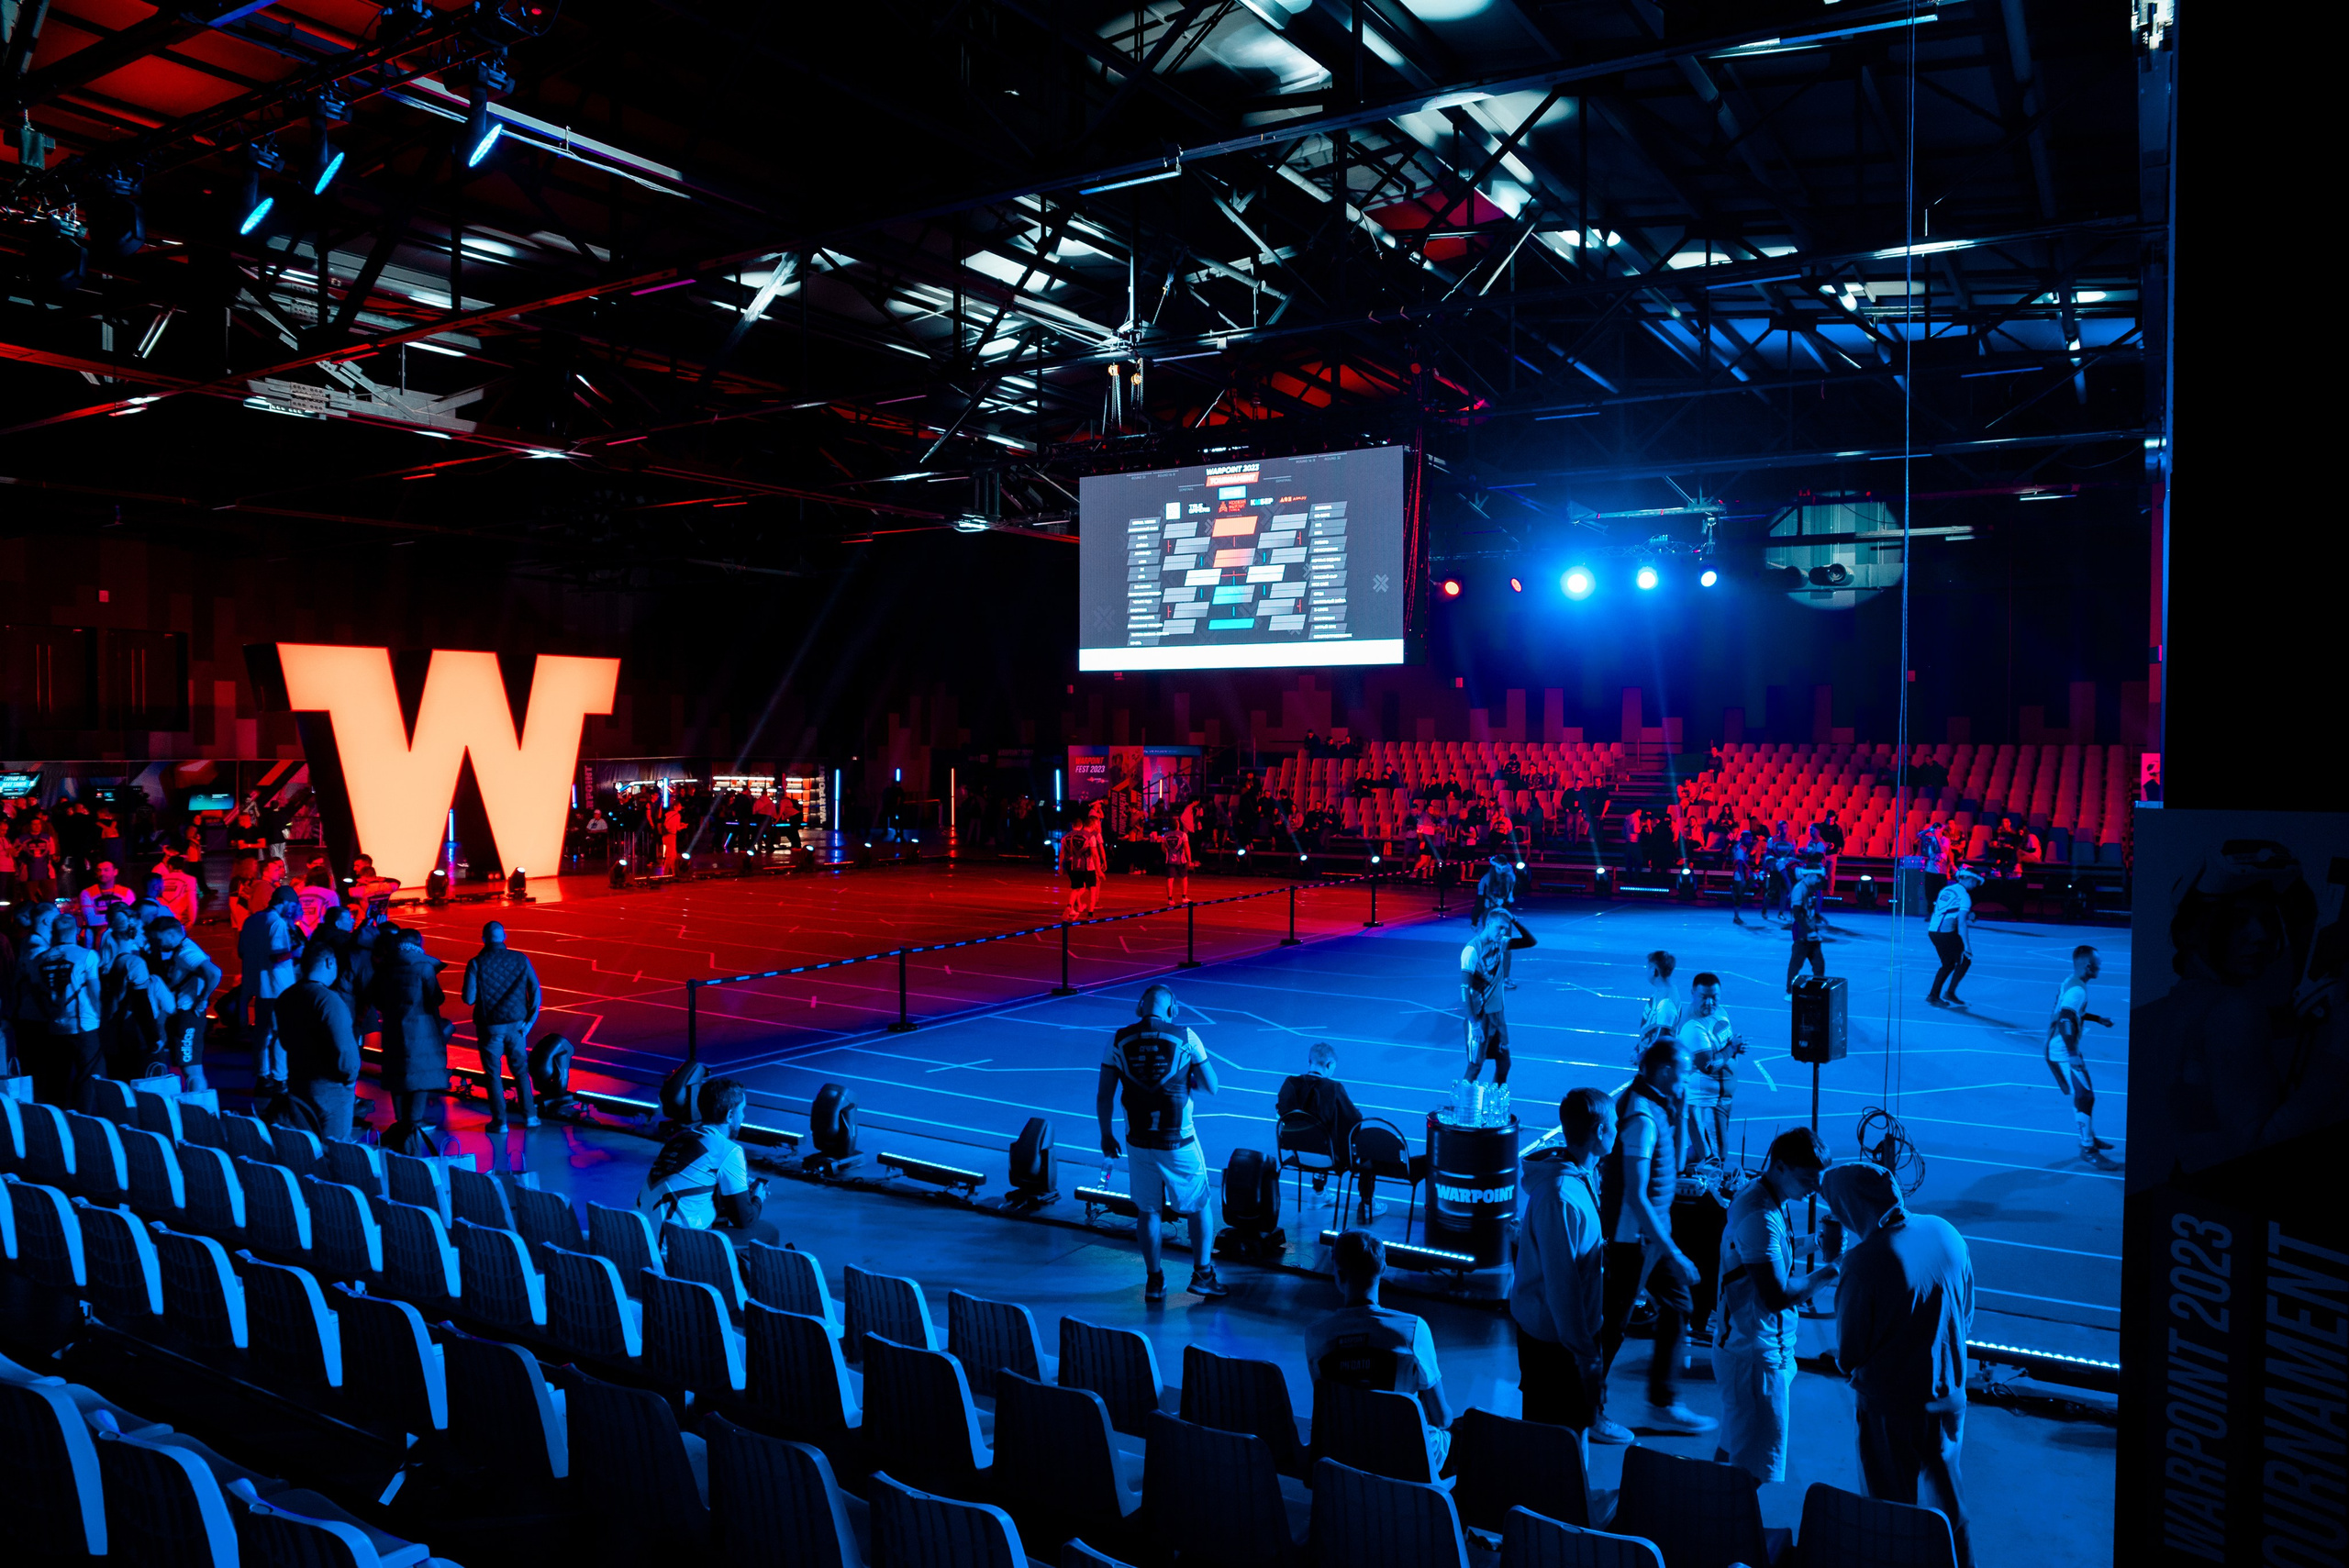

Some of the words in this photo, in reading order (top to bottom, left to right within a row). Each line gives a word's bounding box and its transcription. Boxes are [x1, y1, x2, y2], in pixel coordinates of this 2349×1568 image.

[1206, 465, 1241, 476] WARPOINT
[1242, 463, 1260, 473] 2023
[1209, 473, 1256, 484] TOURNAMENT
[276, 642, 621, 889] W
[1075, 765, 1090, 773] FEST
[1090, 765, 1106, 773] 2023
[818, 763, 827, 824] WARPOINT
[181, 1027, 195, 1062] adidas
[1434, 1183, 1515, 1204] WARPOINT
[2168, 1212, 2232, 1333] 2023
[2164, 1327, 2229, 1563] WARPOINT
